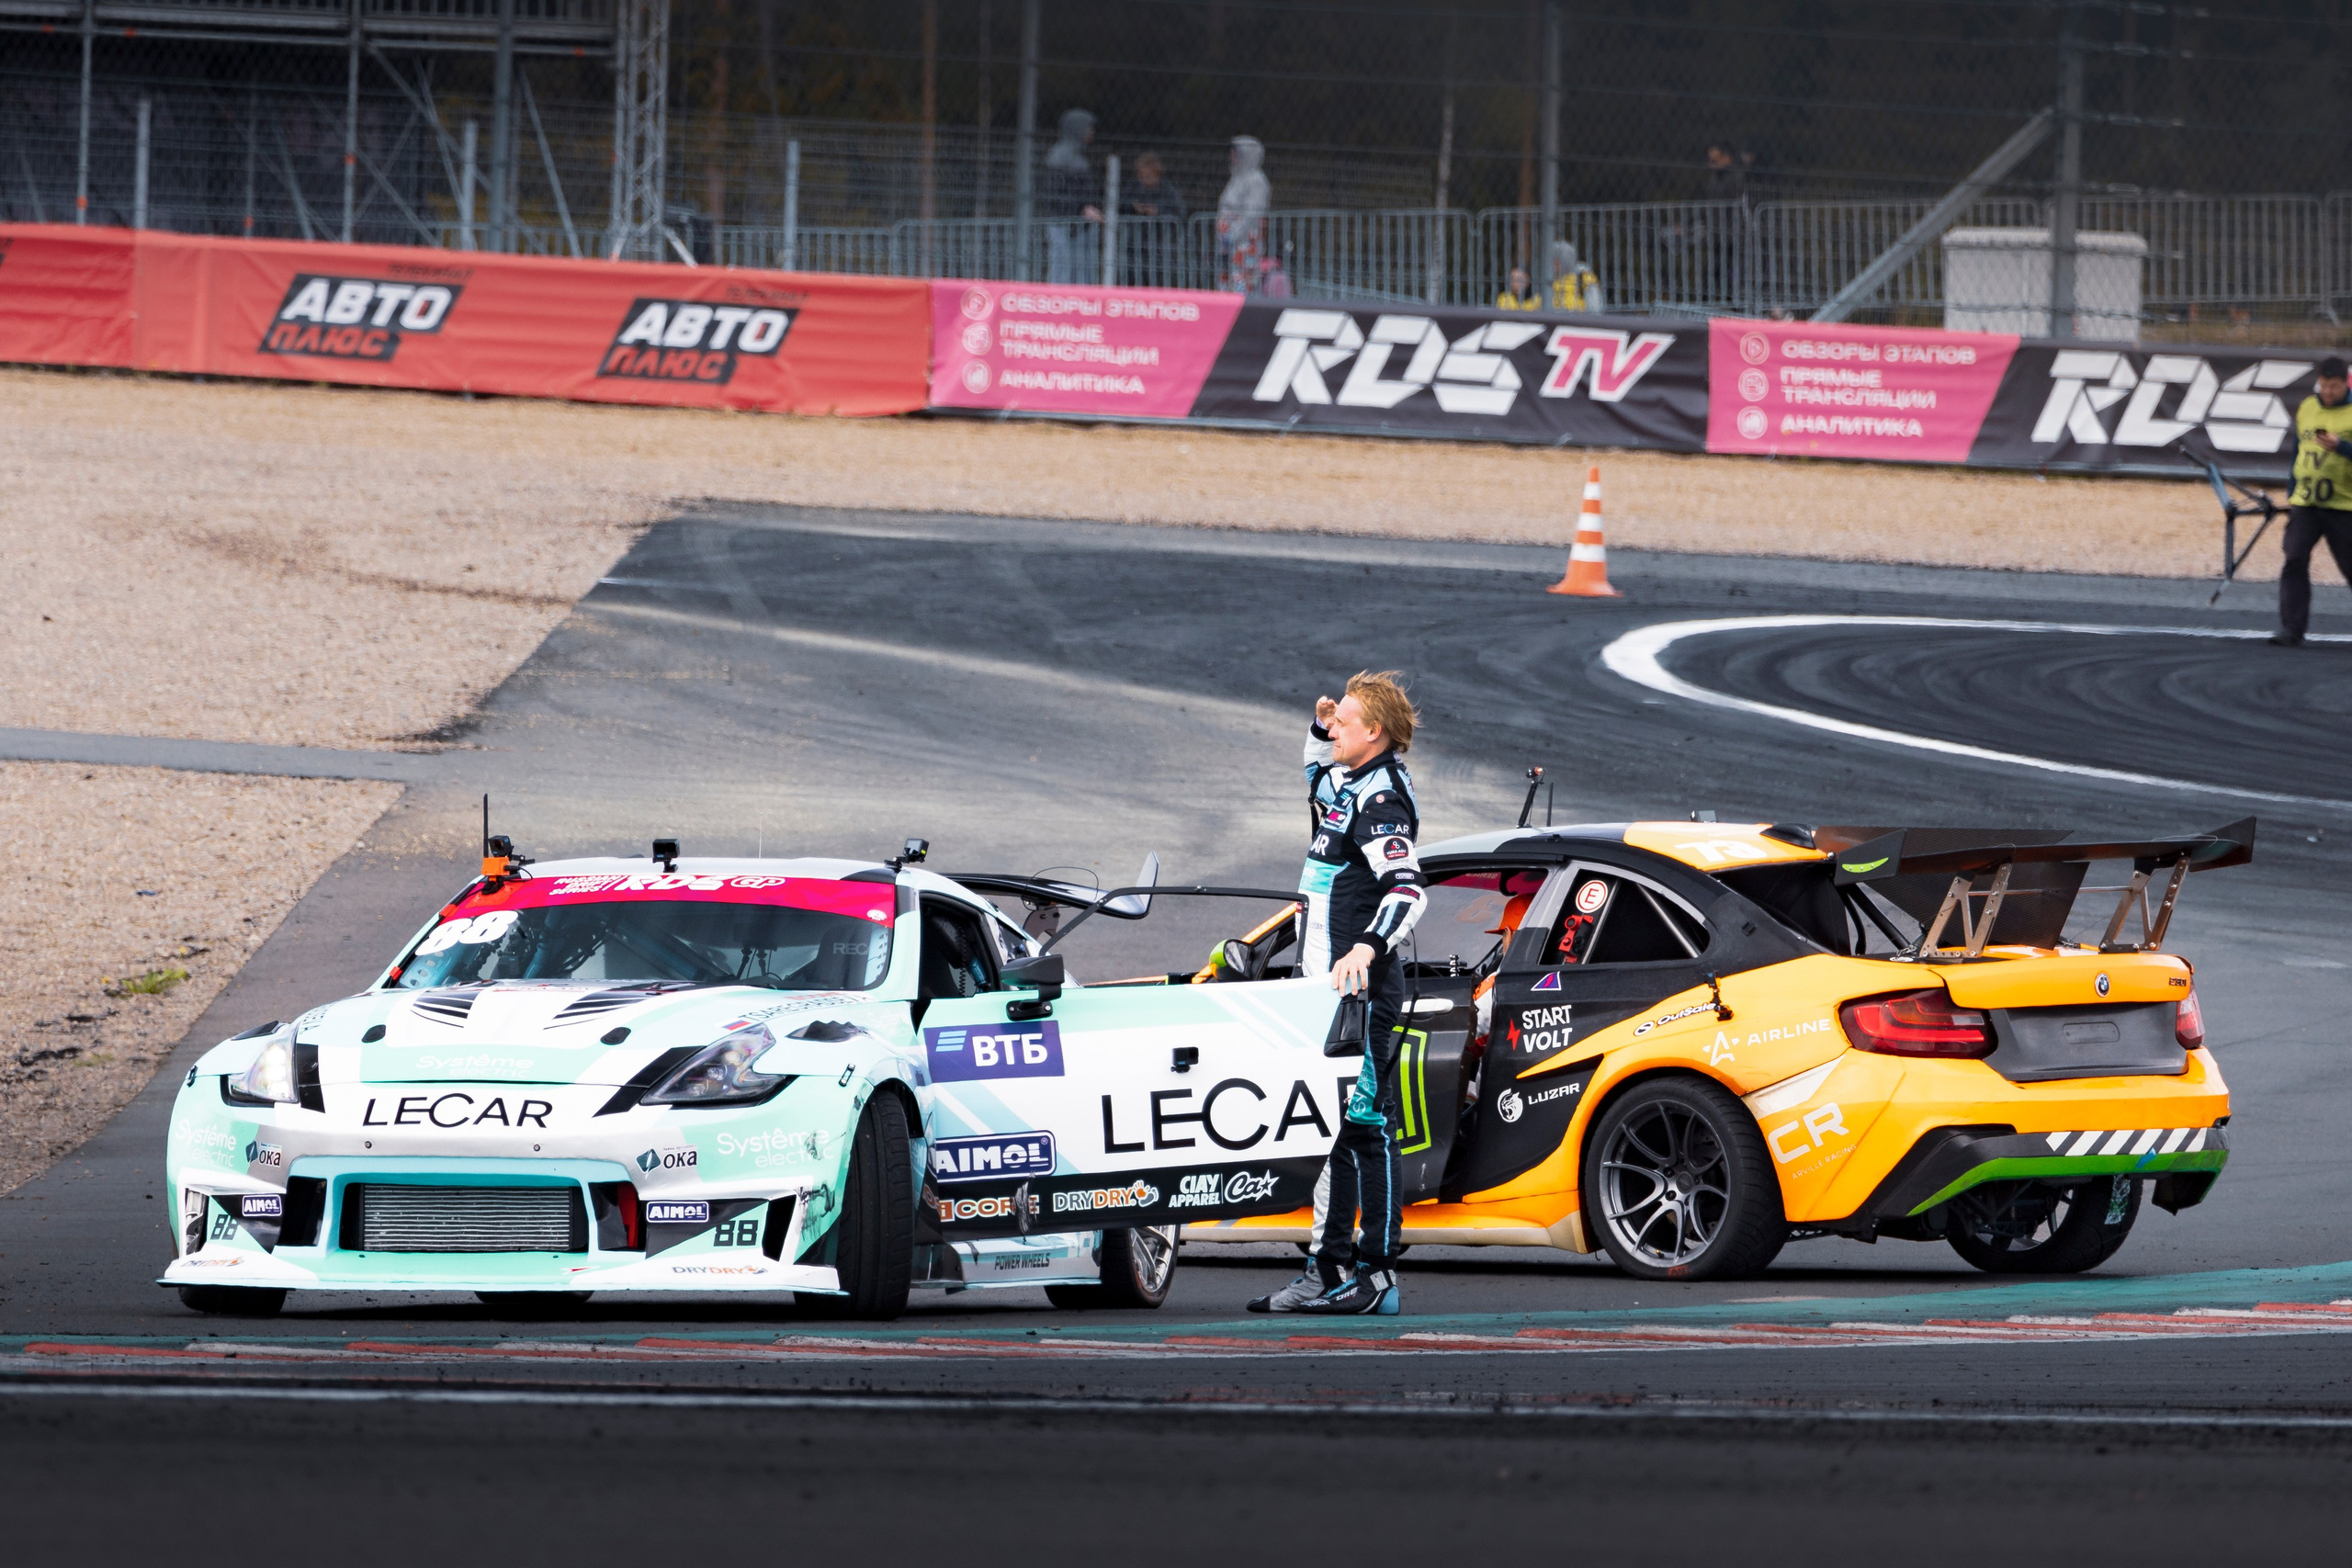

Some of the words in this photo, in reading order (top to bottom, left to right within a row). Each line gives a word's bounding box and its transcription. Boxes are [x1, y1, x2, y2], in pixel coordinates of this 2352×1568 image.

[279, 277, 452, 330] АВТО
[1001, 292, 1102, 317] ОБЗОРЫ
[1105, 298, 1201, 321] ЭТАПОВ
[266, 323, 390, 356] ПЛЮС
[617, 302, 789, 353] АВТО
[1000, 320, 1103, 344] ПРЯМЫЕ
[605, 345, 729, 379] ПЛЮС
[1000, 339, 1159, 367] ТРАНСЛЯЦИИ
[1252, 308, 1547, 416] RDS
[1539, 325, 1677, 402] TV
[1781, 339, 1880, 362] ОБЗОРЫ
[1883, 344, 1977, 366] ЭТАПОВ
[999, 369, 1146, 395] АНАЛИТИКА
[1780, 367, 1883, 389] ПРЯМЫЕ
[1781, 386, 1937, 410] ТРАНСЛЯЦИИ
[2030, 349, 2315, 453] RDS
[1780, 414, 1924, 438] АНАЛИТИКА
[1371, 823, 1409, 835] LECAR
[613, 874, 737, 891] RDS
[730, 875, 786, 889] GP
[414, 909, 519, 956] 88
[1521, 1004, 1572, 1030] START
[1522, 1027, 1573, 1054] VOLT
[1747, 1018, 1831, 1047] AIRLINE
[971, 1033, 1048, 1067] ВТБ
[1528, 1083, 1579, 1105] LUZAR
[362, 1092, 553, 1128] LECAR
[717, 1127, 831, 1157] Systême
[1768, 1101, 1849, 1165] CR
[1824, 1144, 1857, 1164] RACING
[243, 1199, 280, 1213] AIMOL
[649, 1205, 706, 1219] AIMOL
[1168, 1192, 1221, 1208] APPAREL
[713, 1220, 759, 1247] 88
[994, 1255, 1022, 1270] POWER
[1021, 1252, 1051, 1269] WHEELS
